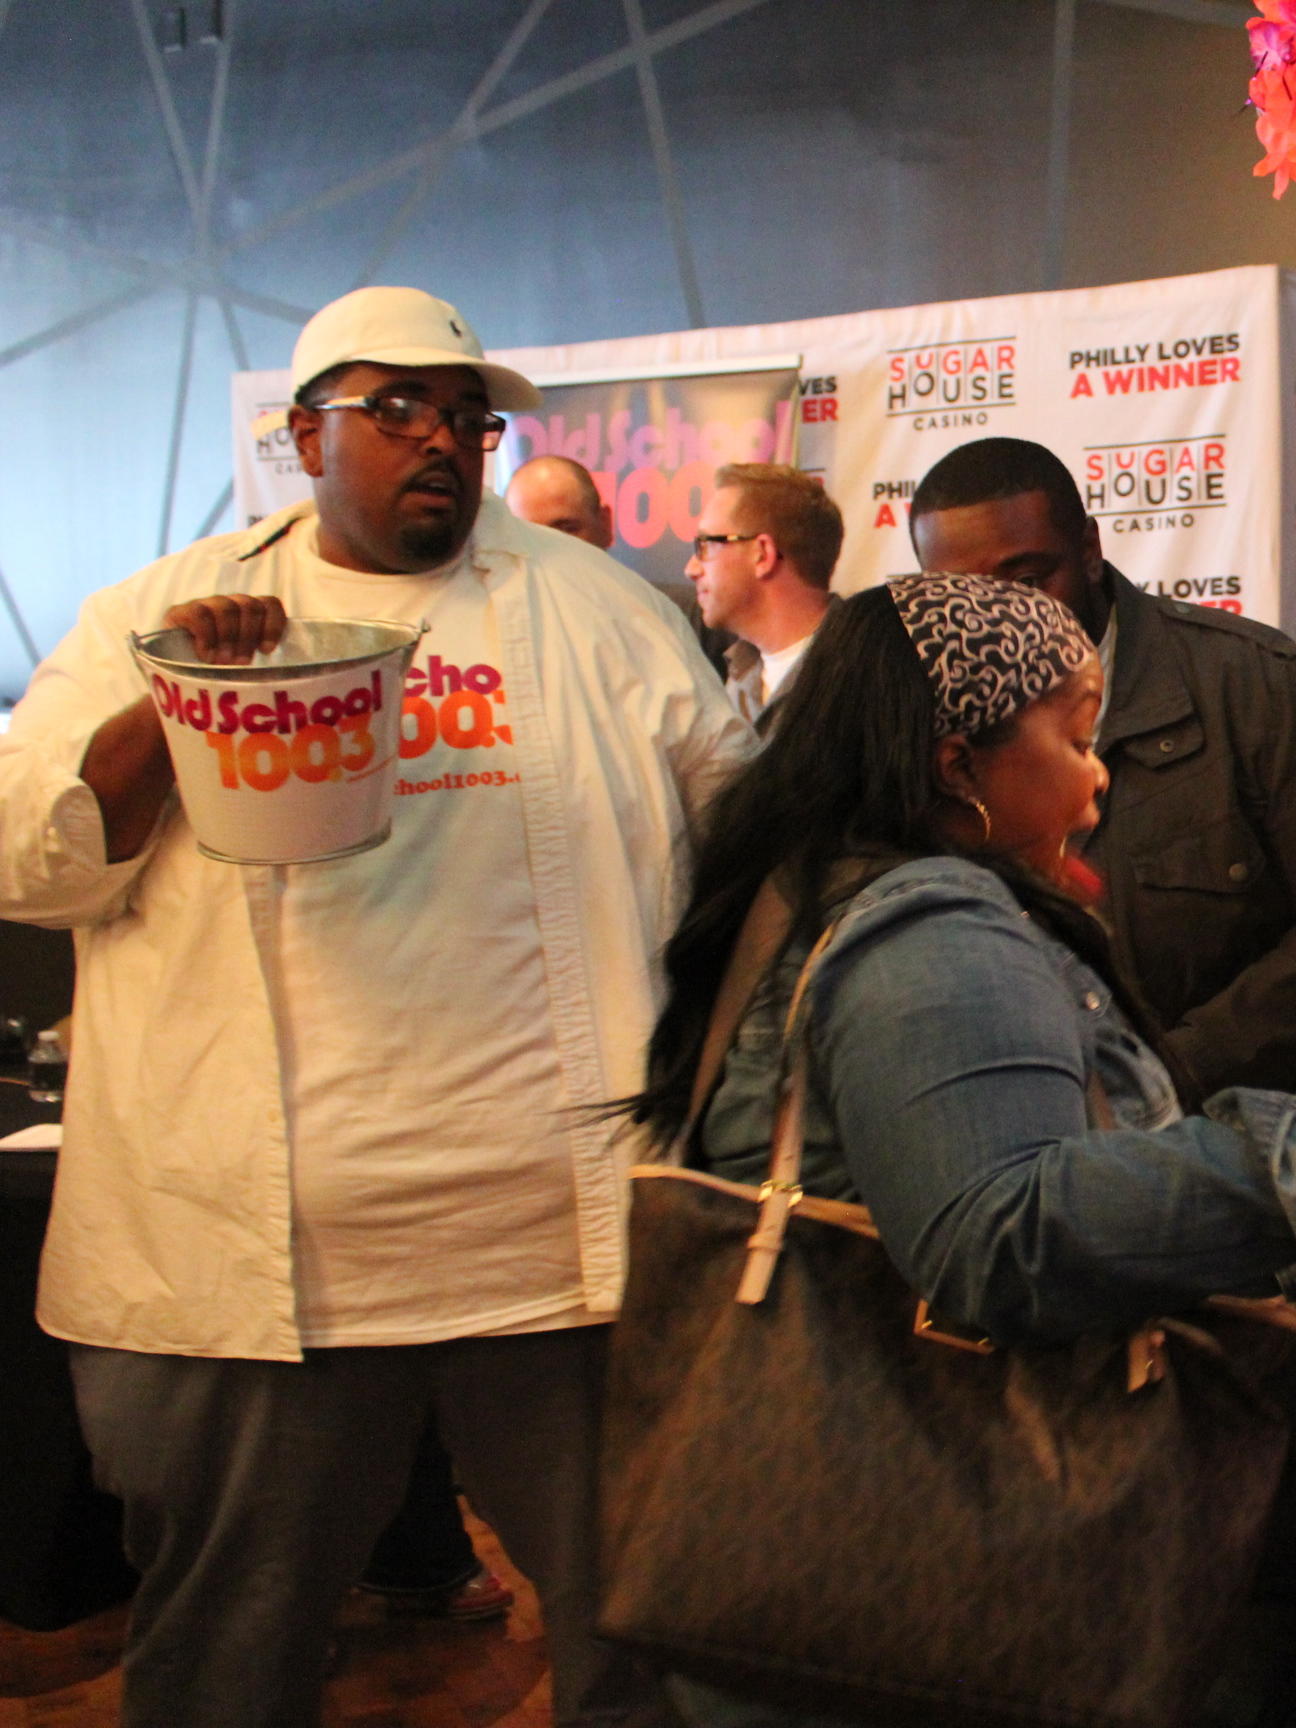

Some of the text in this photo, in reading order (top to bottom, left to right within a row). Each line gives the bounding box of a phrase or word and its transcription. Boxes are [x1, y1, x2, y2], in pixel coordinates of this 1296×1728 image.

[890, 344, 1016, 384] SUGAR
[1069, 334, 1240, 370] PHILLY LOVES
[799, 376, 837, 396] VES
[888, 371, 1014, 411] HOUSE
[1070, 357, 1240, 399] A WINNER
[913, 412, 989, 431] CASINO
[1086, 442, 1226, 482] SUGAR
[1085, 471, 1225, 510] HOUSE
[874, 503, 896, 528] A
[1113, 513, 1195, 533] CASINO
[1157, 576, 1241, 600] LOVES
[152, 669, 383, 735] Old School
